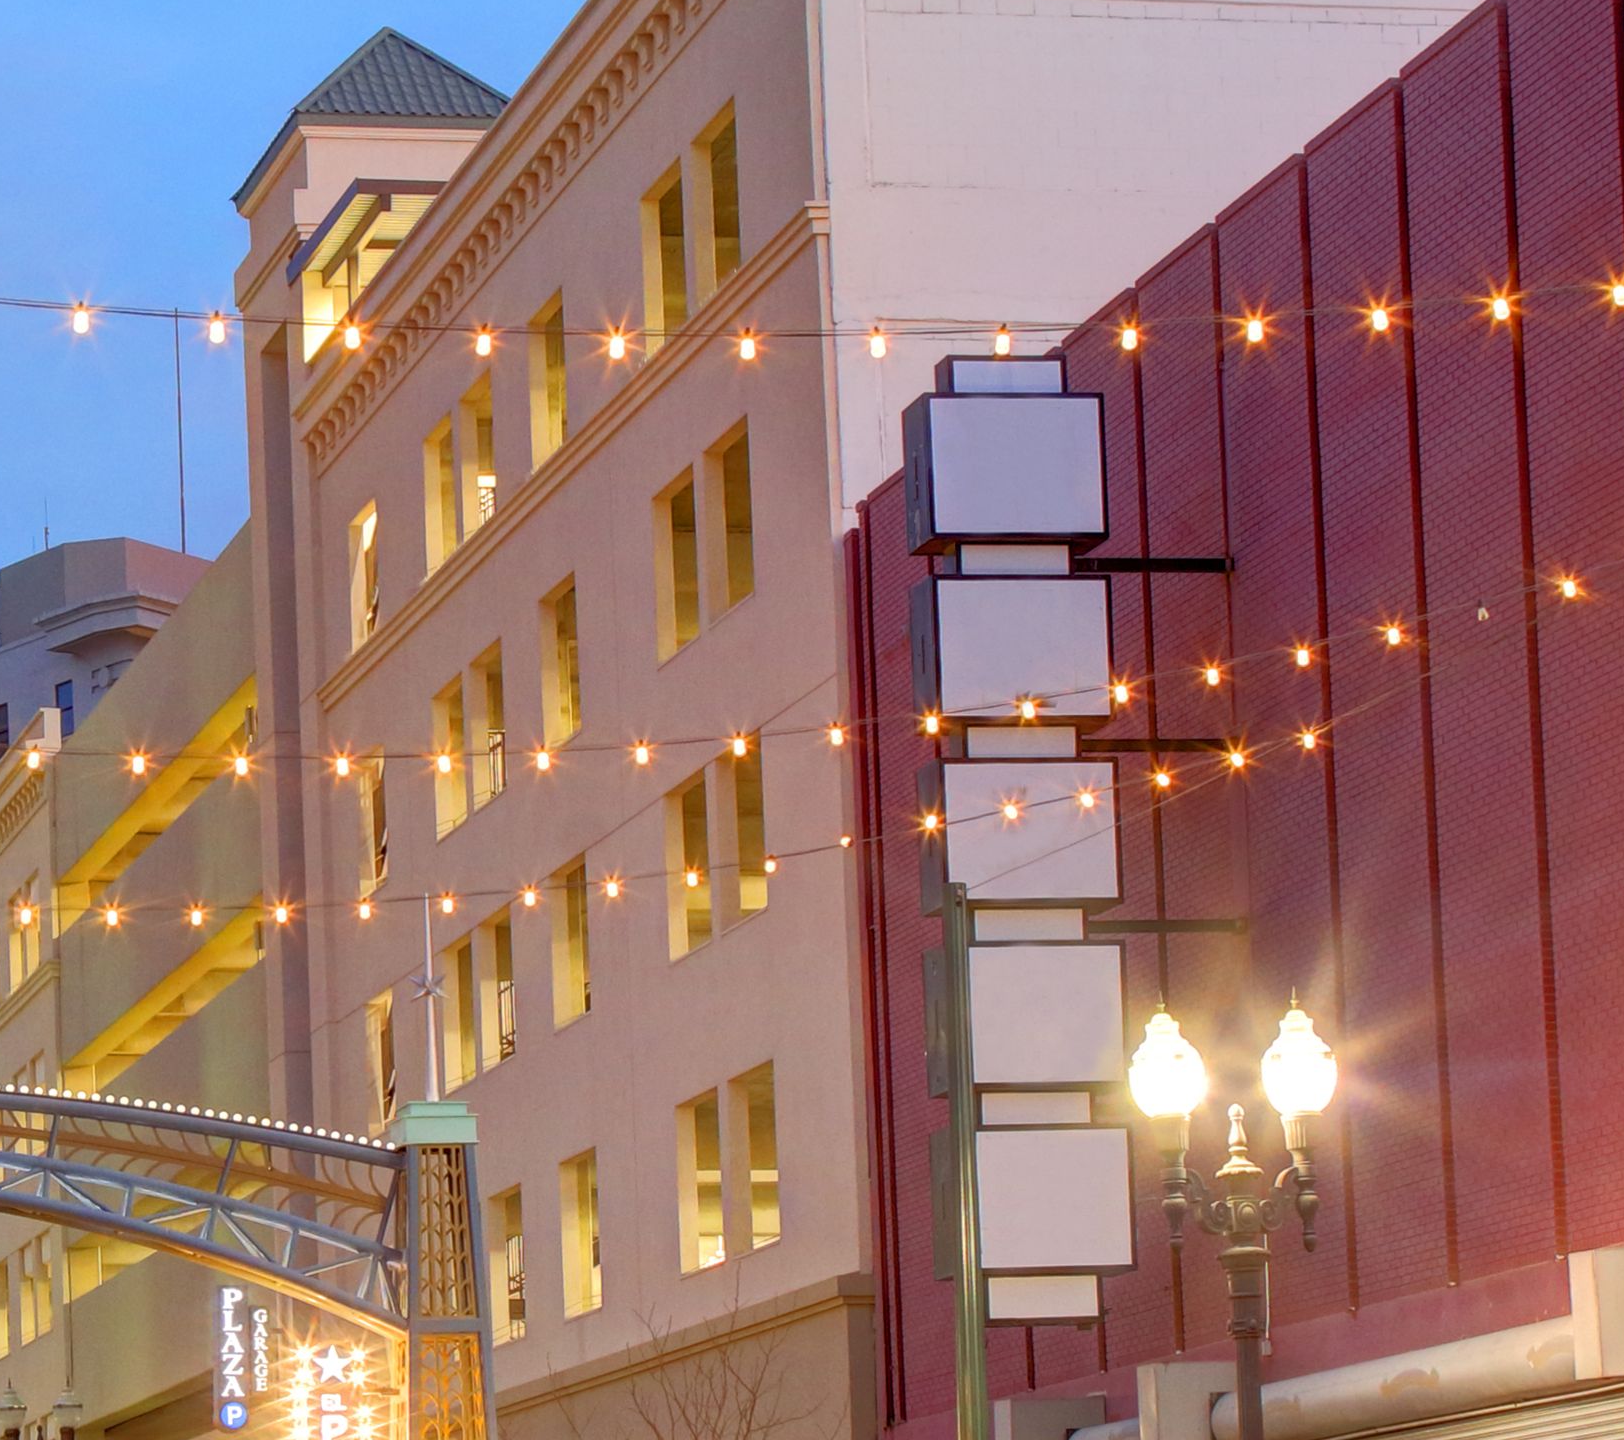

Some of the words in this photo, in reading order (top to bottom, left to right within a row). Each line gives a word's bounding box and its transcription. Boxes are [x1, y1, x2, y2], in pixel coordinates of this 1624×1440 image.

[220, 1287, 246, 1398] PLAZA
[253, 1308, 269, 1392] GARAGE
[320, 1393, 348, 1412] EL
